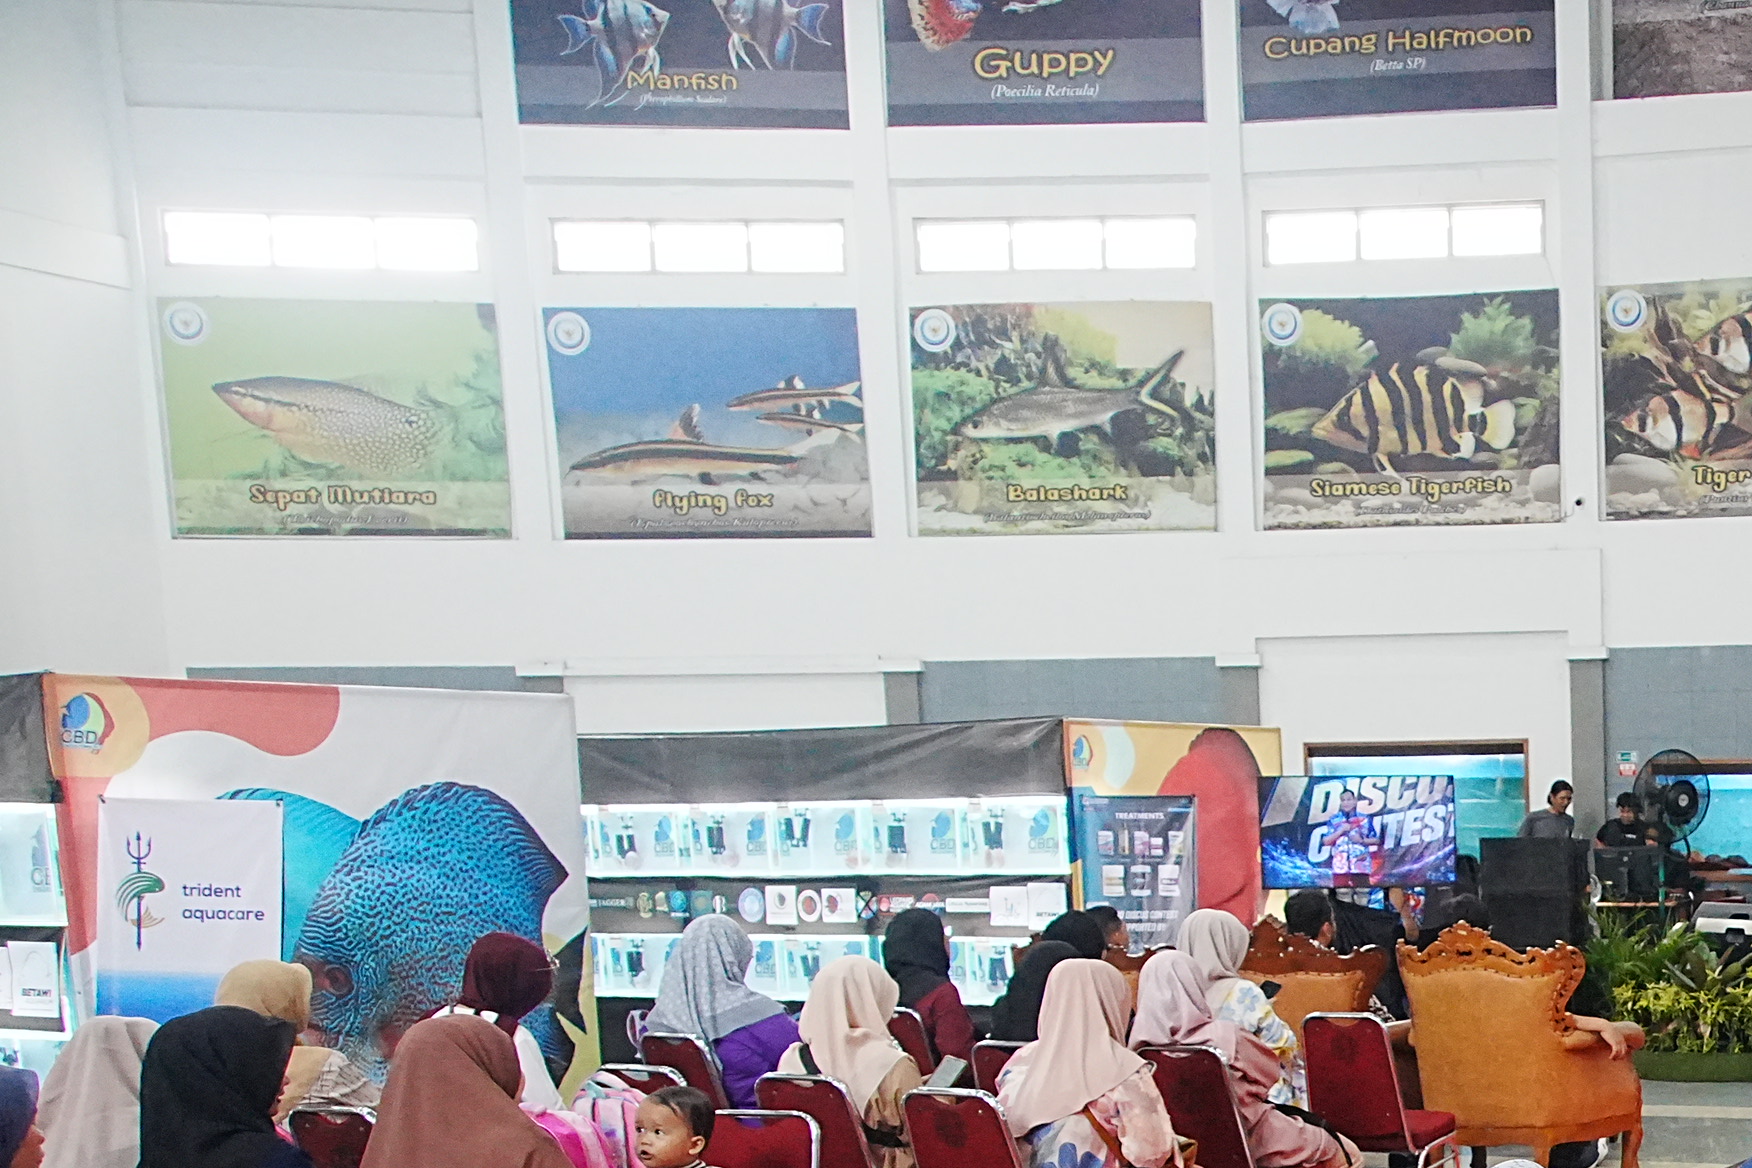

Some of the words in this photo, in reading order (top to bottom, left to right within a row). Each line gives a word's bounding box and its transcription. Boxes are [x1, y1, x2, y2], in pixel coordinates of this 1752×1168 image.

[1264, 33, 1377, 59] Cupang
[1387, 25, 1533, 53] Halfmoon
[973, 47, 1115, 79] Guppy
[626, 70, 738, 91] Manfish
[1310, 479, 1401, 497] Siamese
[1406, 475, 1512, 503] Tigerfish
[1692, 464, 1752, 492] Tiger
[249, 483, 321, 511] Sepat
[327, 484, 437, 505] Mutiara
[1006, 483, 1128, 502] Balashark
[61, 730, 97, 744] CBD
[182, 883, 241, 897] trident
[182, 908, 265, 923] aquacare
